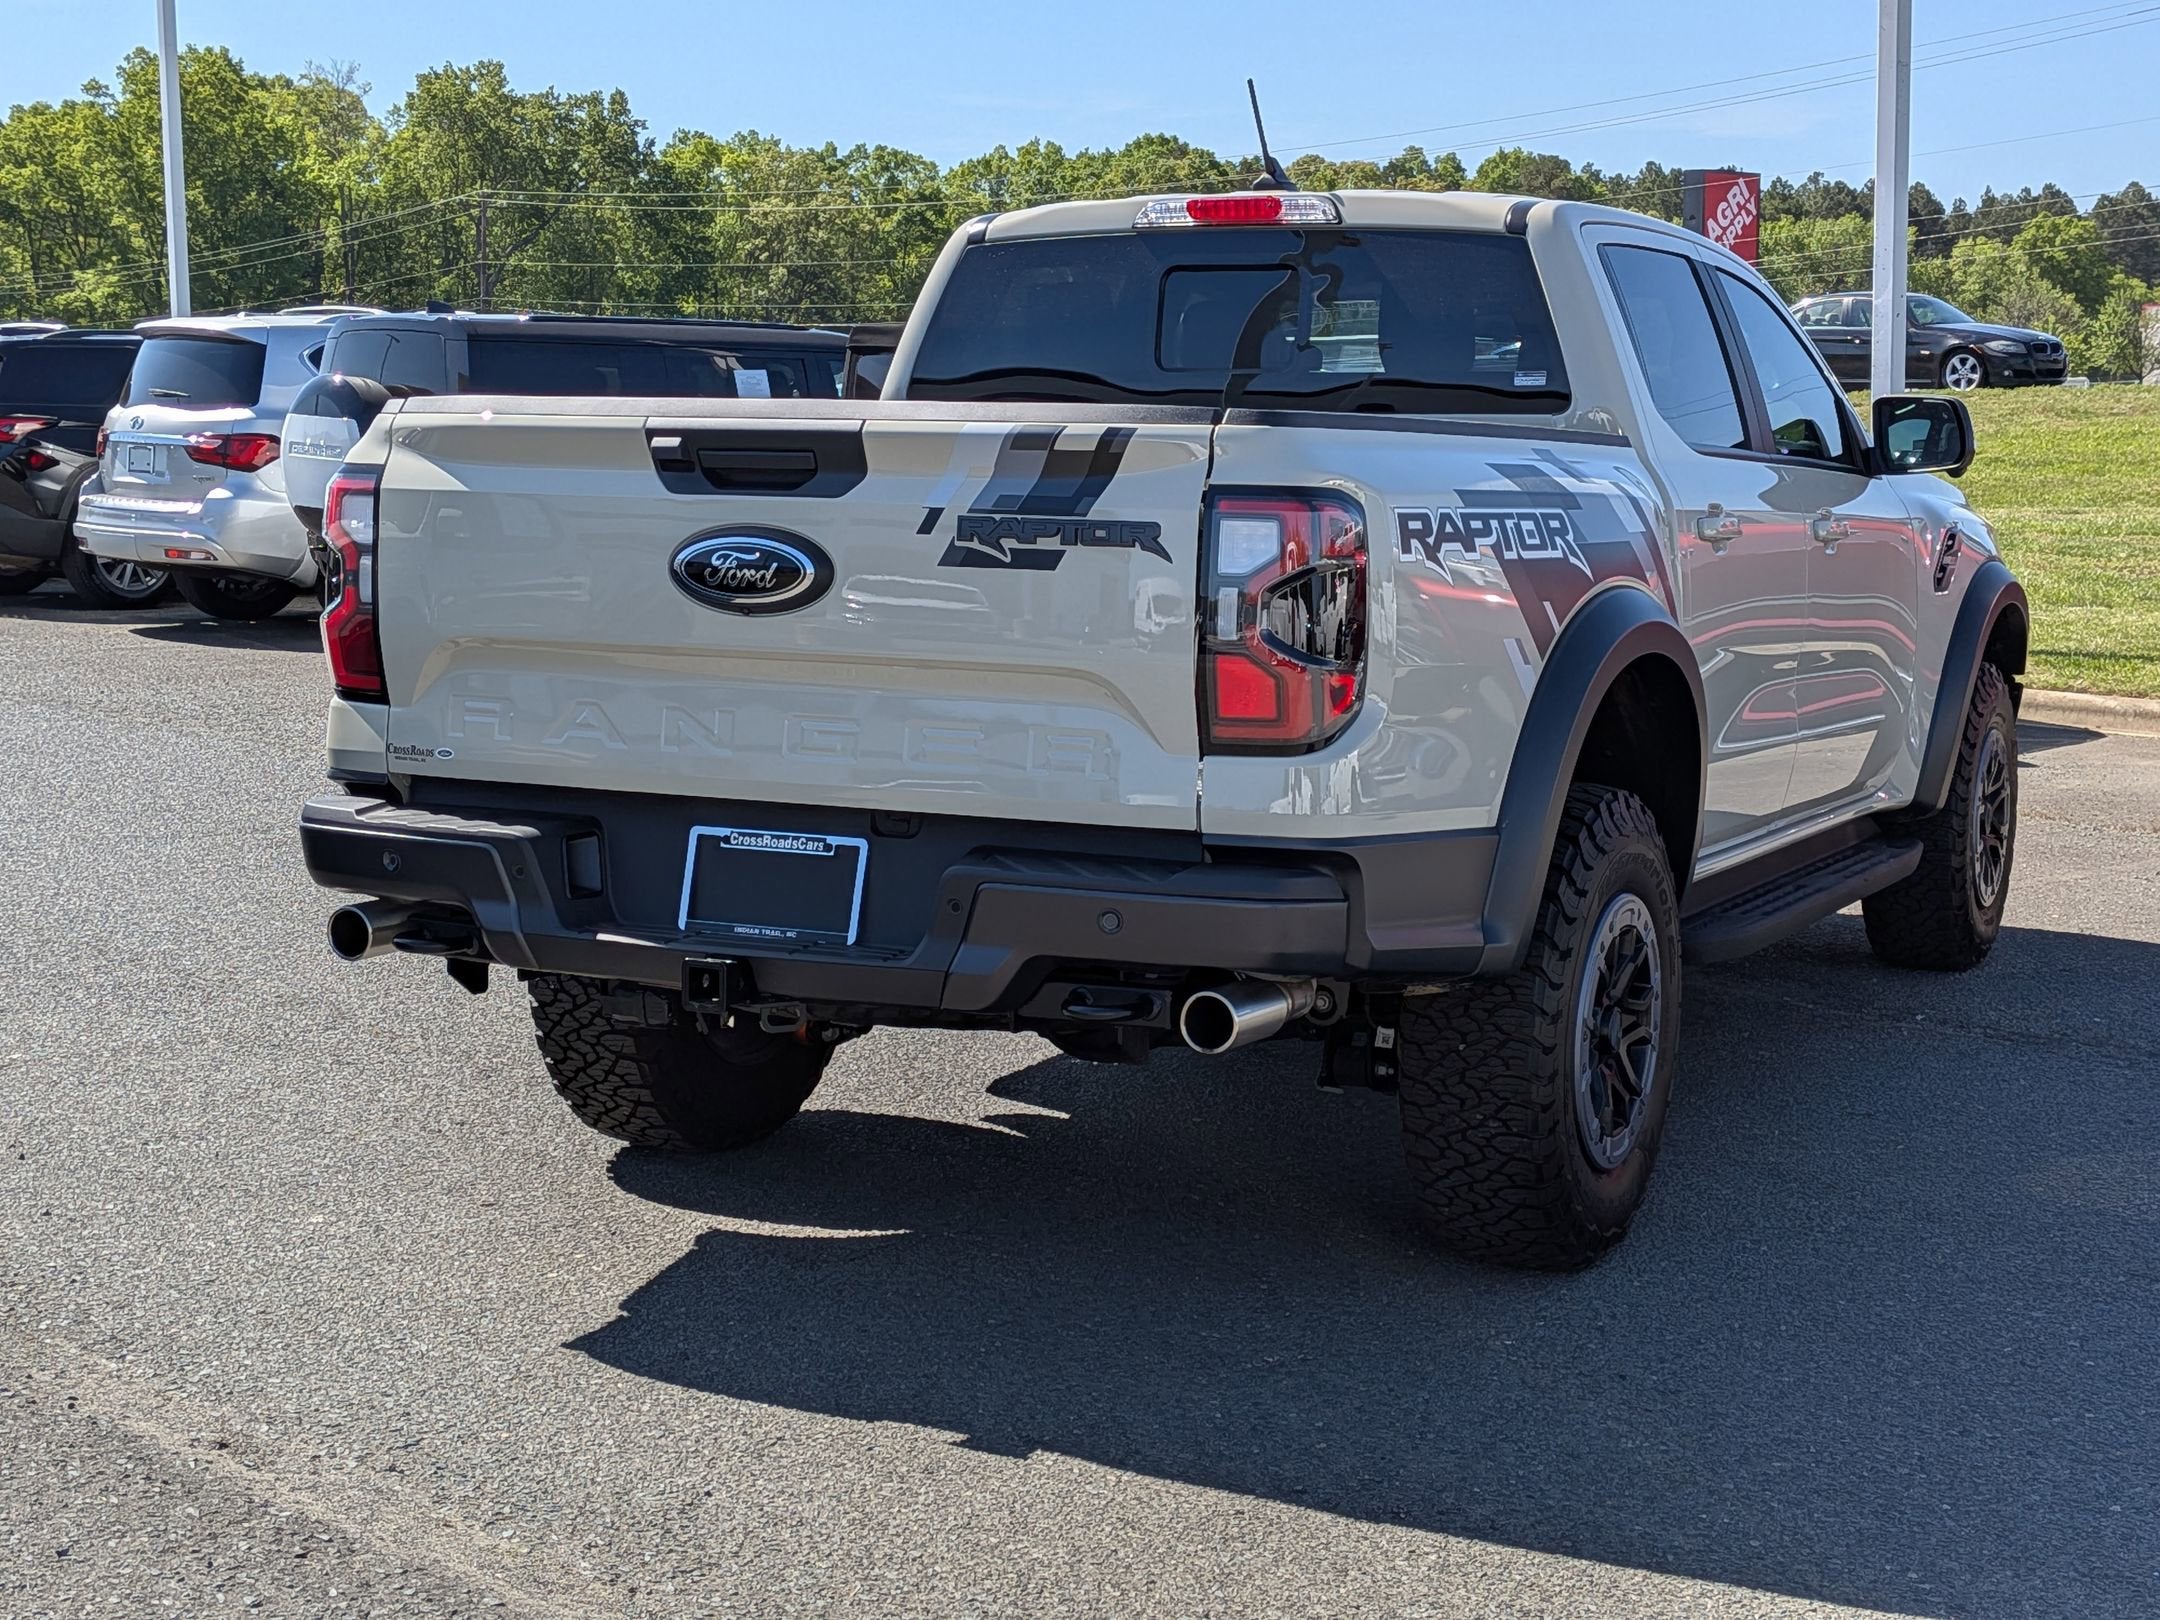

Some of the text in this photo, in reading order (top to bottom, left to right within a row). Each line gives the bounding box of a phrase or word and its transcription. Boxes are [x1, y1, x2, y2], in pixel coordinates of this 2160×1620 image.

[1707, 178, 1750, 240] AGRI
[1718, 194, 1757, 249] PPLY
[956, 515, 1173, 564] RAPTOR
[1392, 506, 1595, 587] RAPTOR
[703, 549, 779, 588] Ford
[446, 692, 1122, 783] RANGER
[729, 832, 825, 851] CrossRoadsCars
